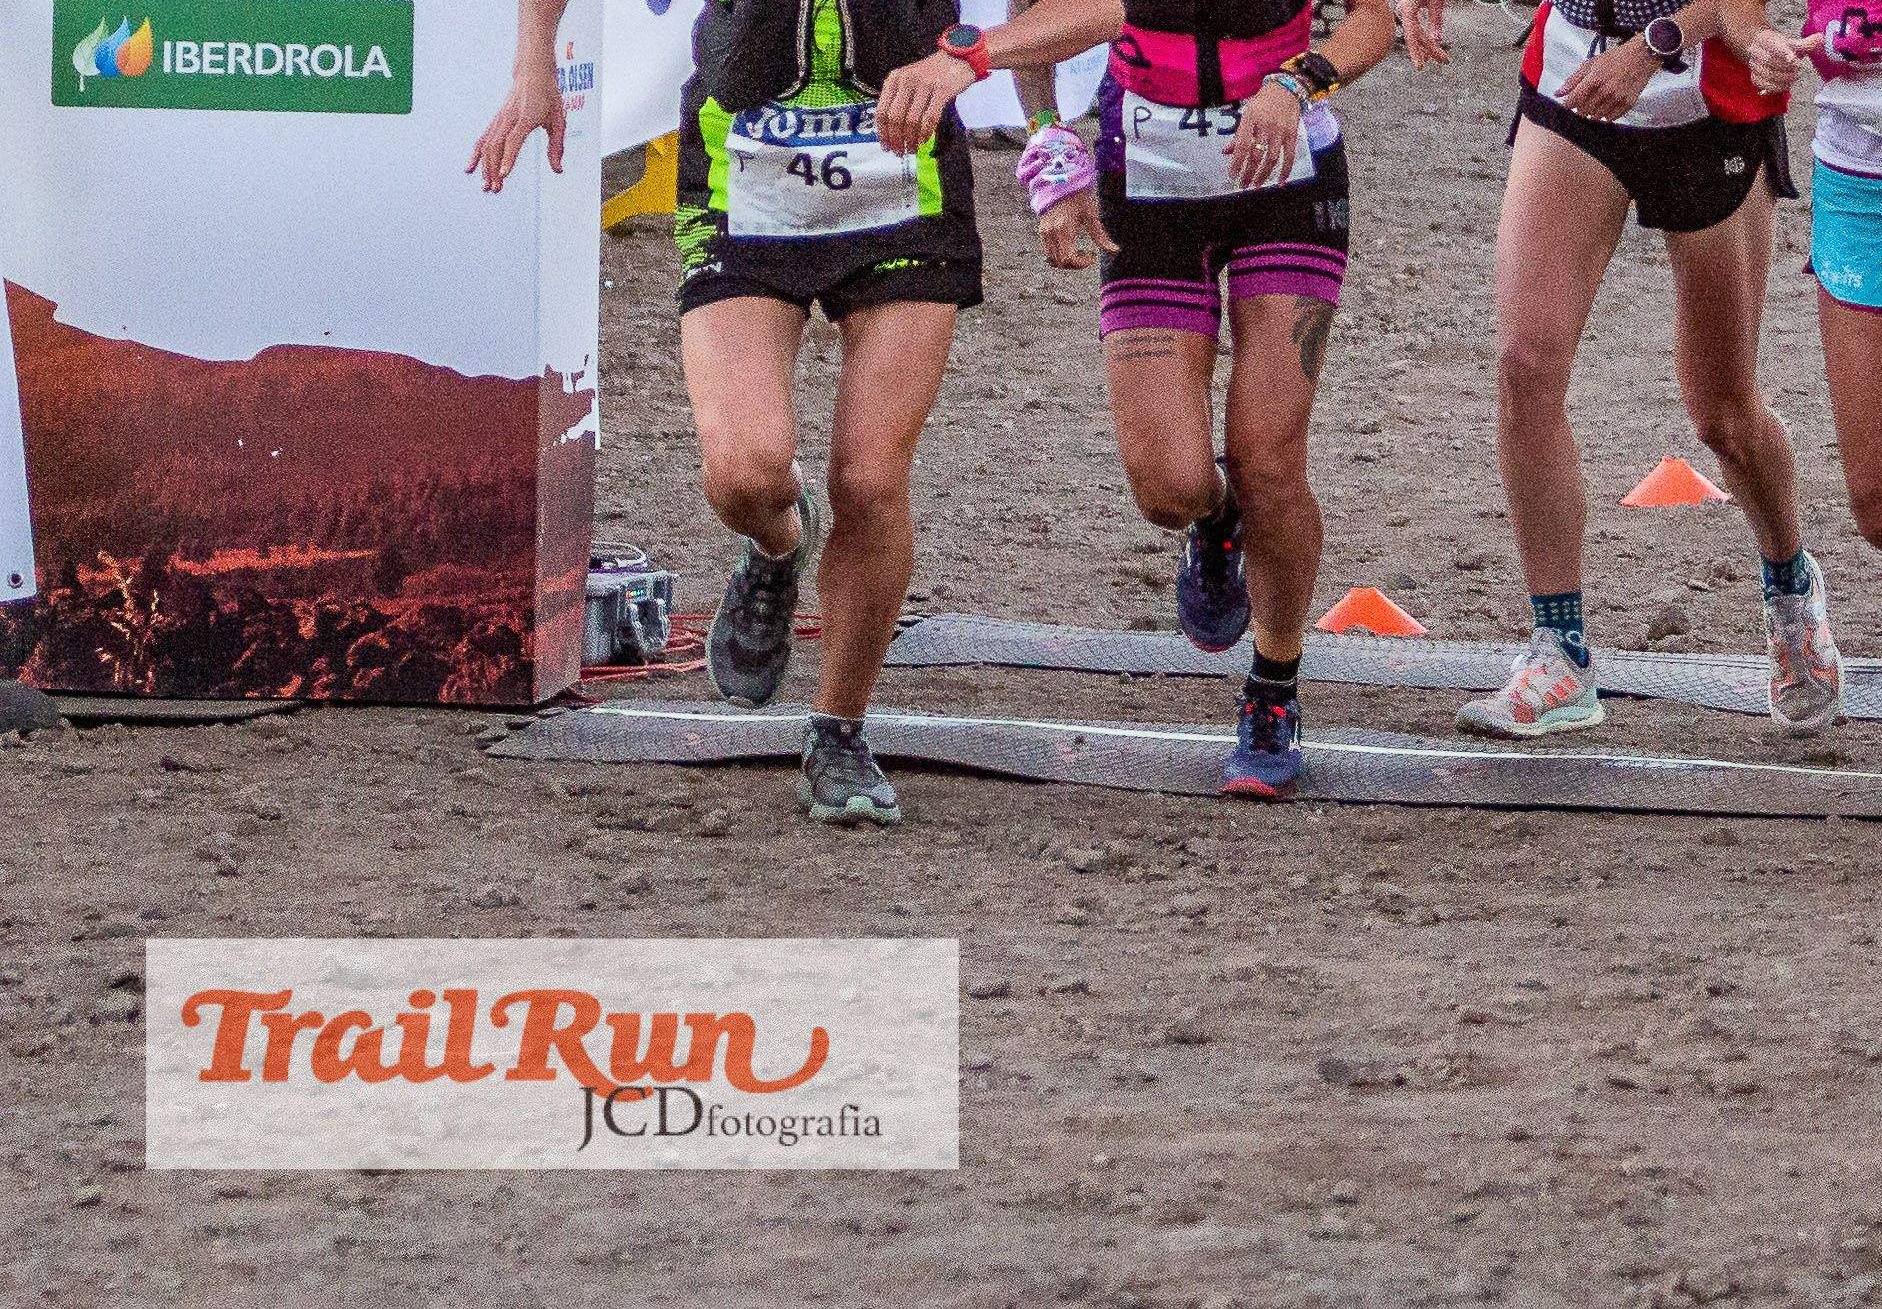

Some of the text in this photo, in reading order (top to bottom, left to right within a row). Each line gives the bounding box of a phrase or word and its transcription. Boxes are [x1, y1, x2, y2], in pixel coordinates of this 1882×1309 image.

[162, 39, 392, 79] IBERDROLA
[1133, 104, 1241, 140] P 43
[787, 150, 853, 190] 46
